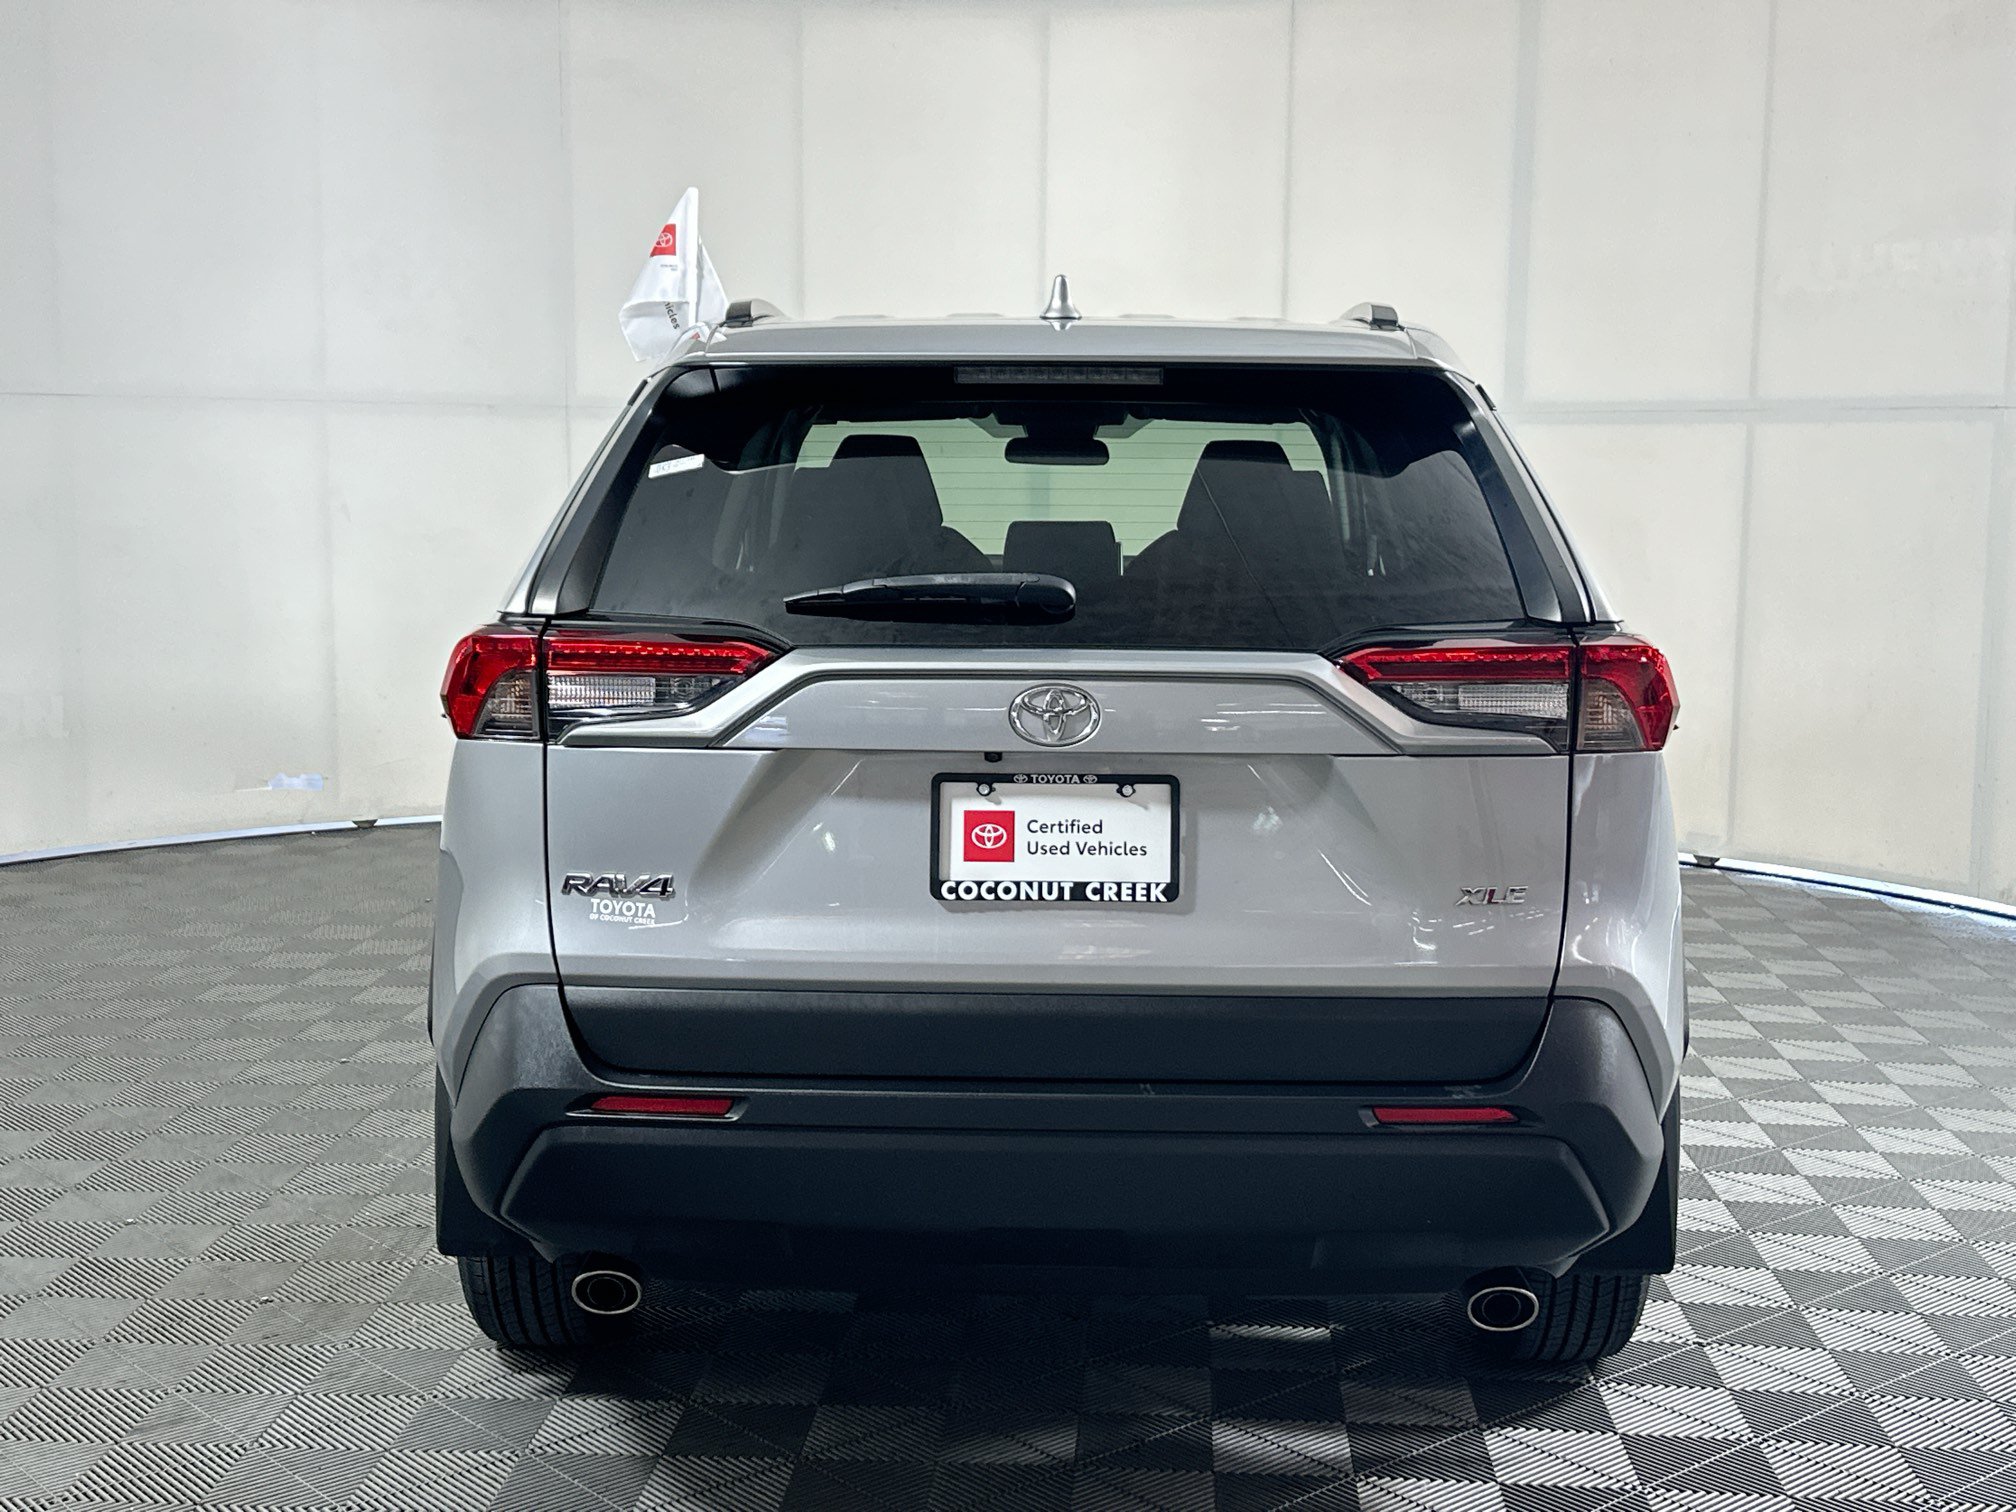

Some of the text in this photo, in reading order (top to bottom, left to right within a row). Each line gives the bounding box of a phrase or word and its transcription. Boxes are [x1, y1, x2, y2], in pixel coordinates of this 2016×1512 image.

[1030, 774, 1081, 785] TOYOTA
[1026, 819, 1103, 835] Certified
[1026, 841, 1148, 857] Used Vehicles
[561, 872, 676, 901] RAV4
[940, 880, 1168, 902] COCONUT CREEK
[1455, 885, 1529, 905] XLE
[590, 898, 656, 919] TOYOTA
